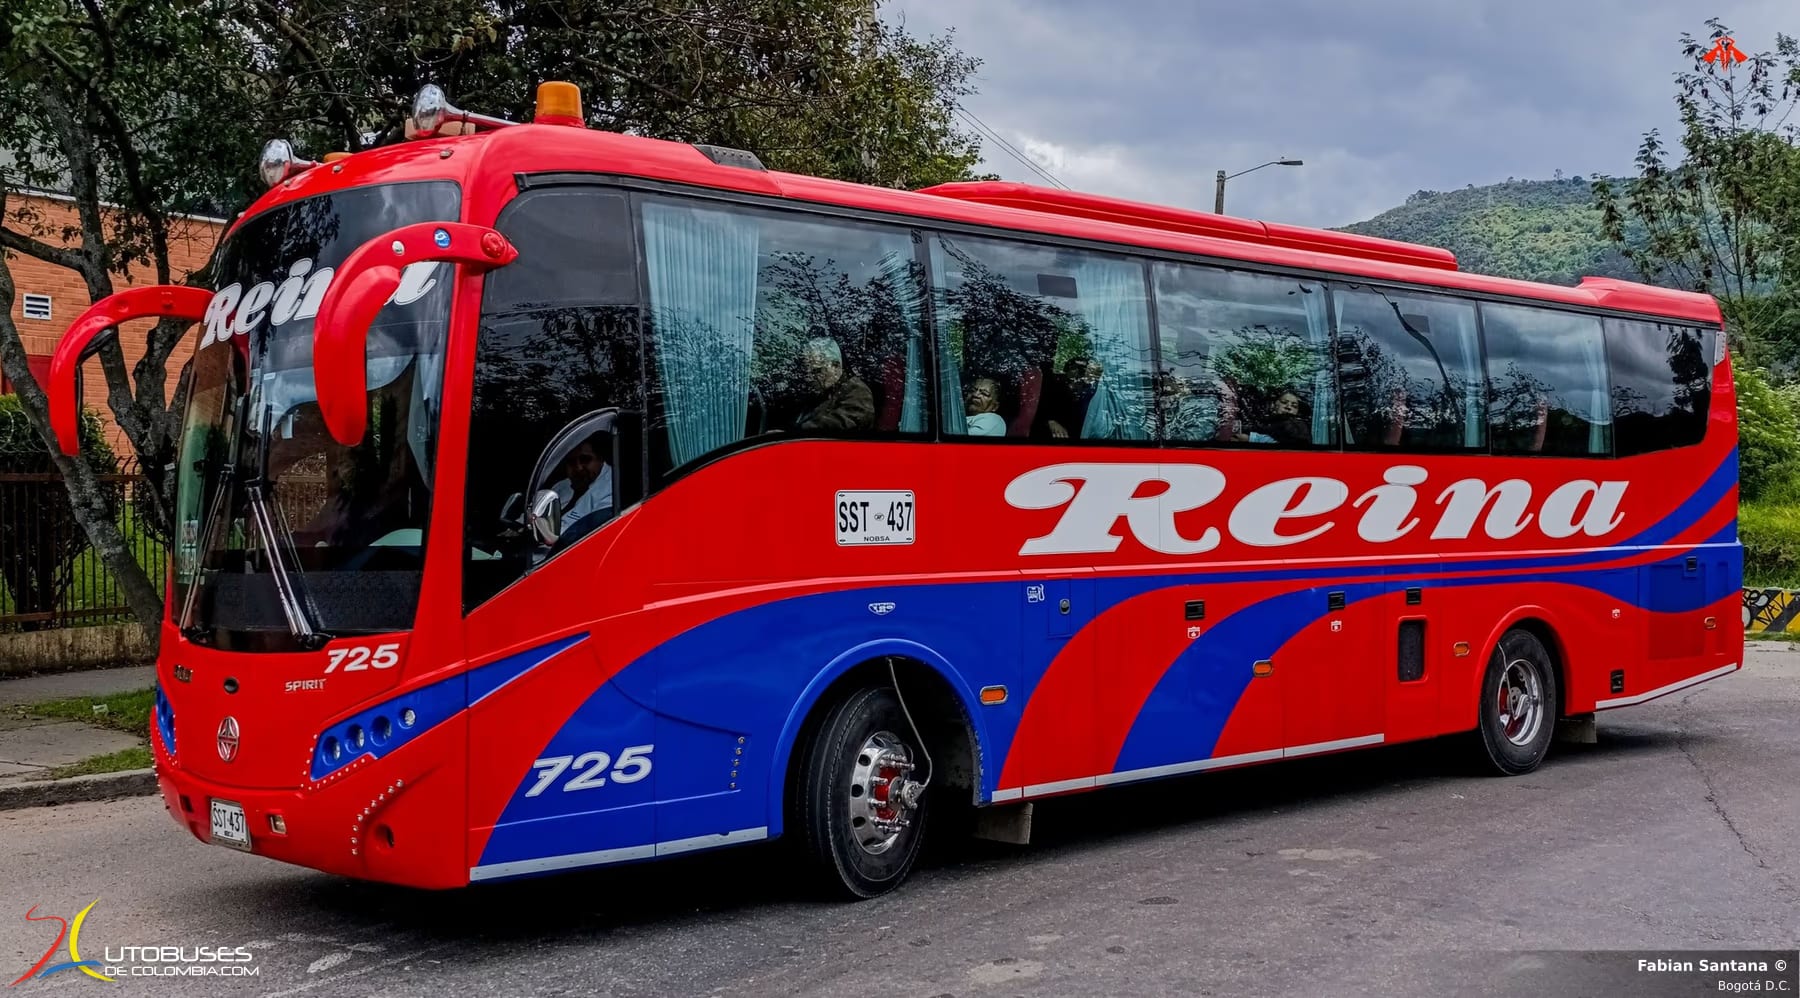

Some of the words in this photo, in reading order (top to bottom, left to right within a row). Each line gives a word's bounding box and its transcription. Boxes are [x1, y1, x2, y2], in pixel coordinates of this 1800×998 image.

[839, 501, 869, 533] SST
[887, 501, 913, 532] 437
[1004, 462, 1630, 556] Reina
[324, 643, 400, 674] 725
[284, 678, 327, 692] SPIRIT
[525, 744, 655, 798] 725
